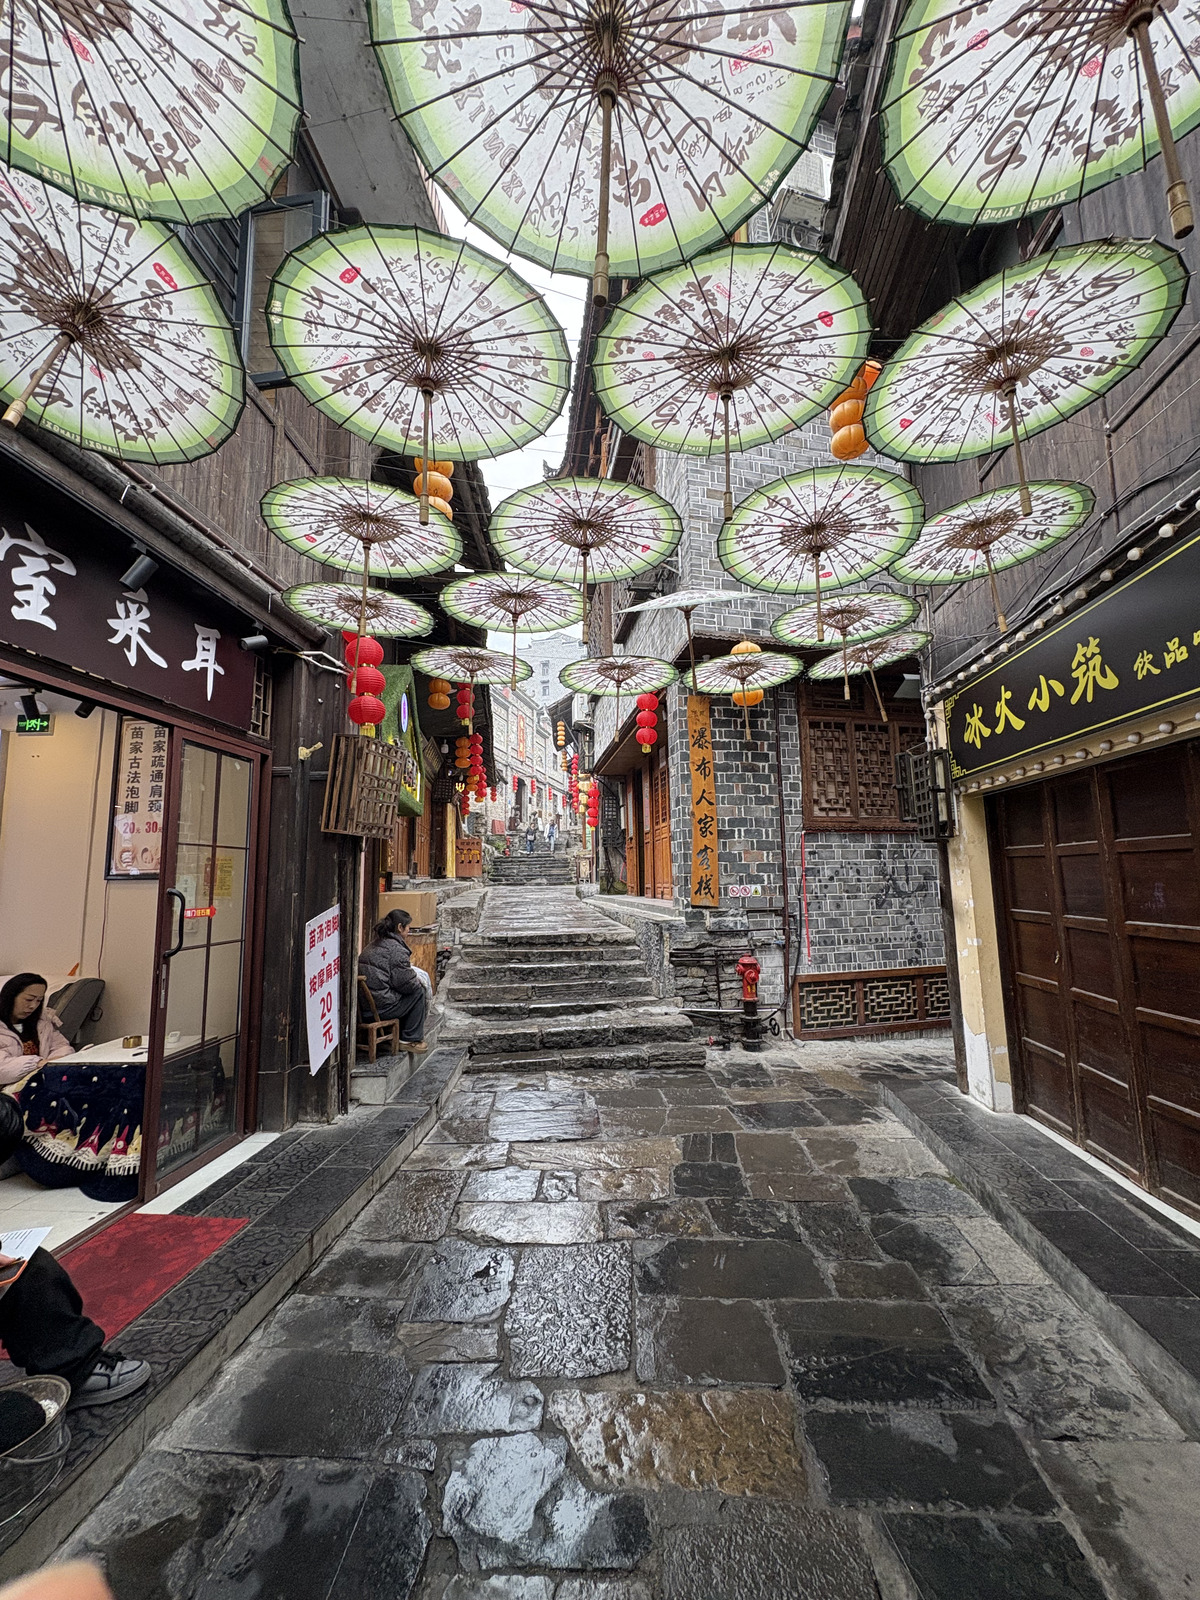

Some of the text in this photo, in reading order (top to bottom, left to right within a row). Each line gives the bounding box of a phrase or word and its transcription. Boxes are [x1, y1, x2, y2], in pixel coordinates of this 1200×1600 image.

[963, 629, 1200, 750] 冰火小筑 饮品
[123, 726, 145, 815] 苗家古法泡脚
[147, 725, 167, 813] 苗家疏通肩颈
[690, 726, 716, 900] 瀑布人家客栈
[308, 913, 340, 951] 苗汤泡脚
[309, 955, 340, 999] 按摩肩颈
[319, 990, 333, 1021] 20
[322, 1018, 334, 1050] 元
